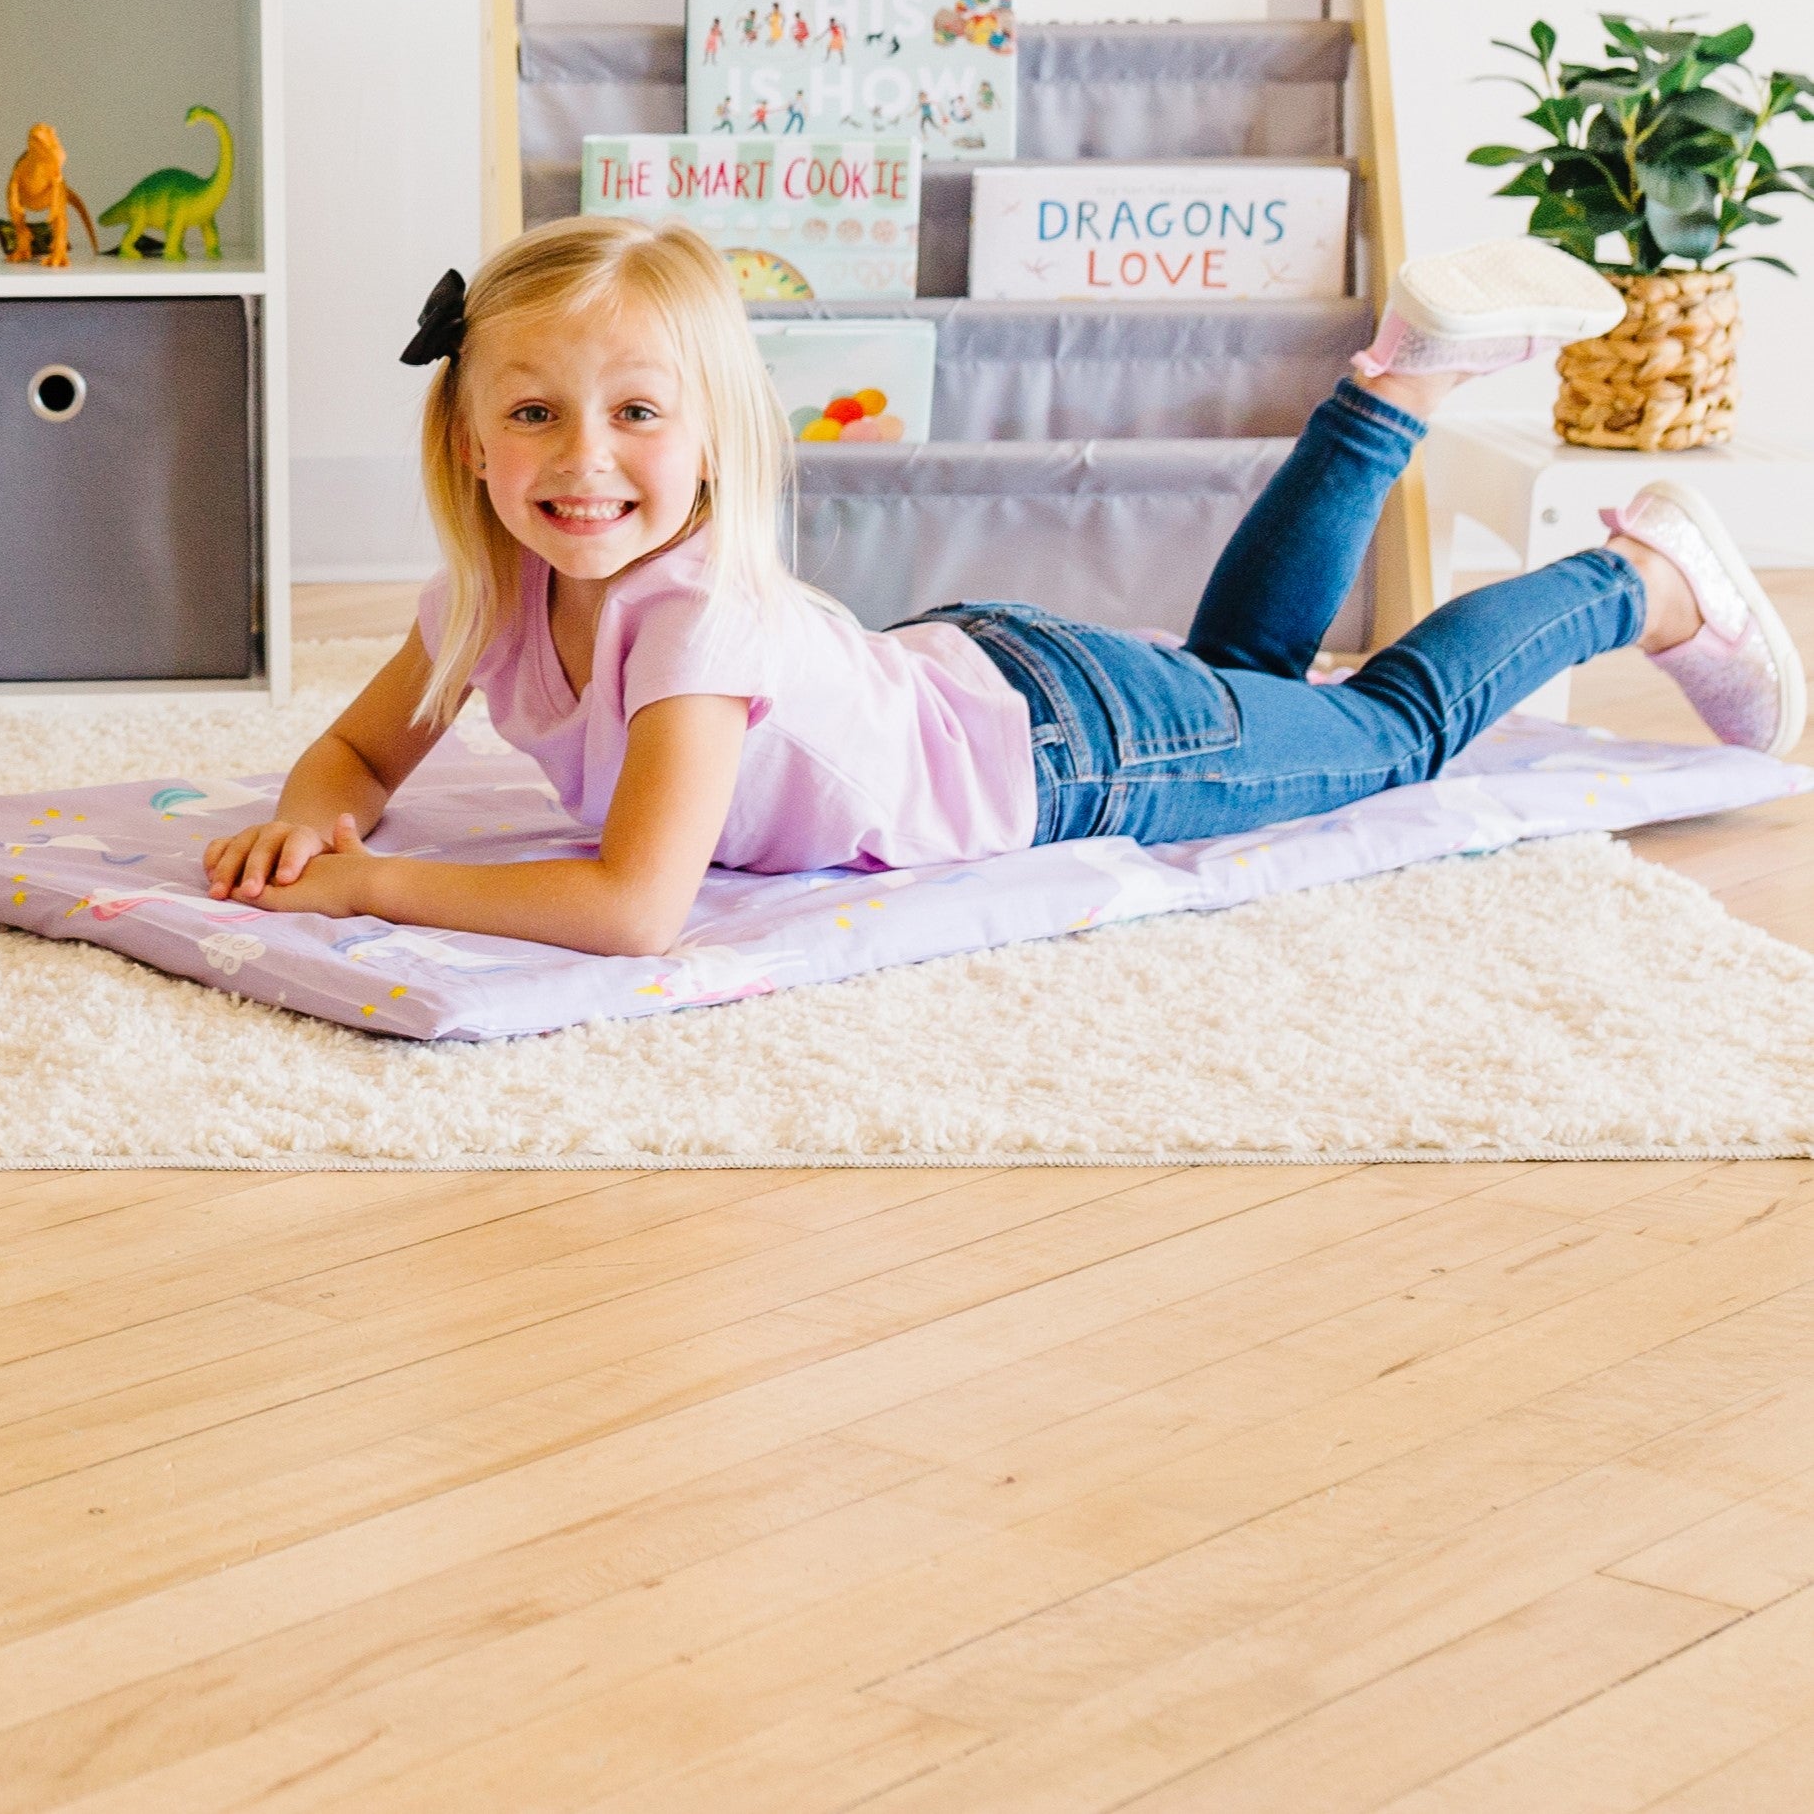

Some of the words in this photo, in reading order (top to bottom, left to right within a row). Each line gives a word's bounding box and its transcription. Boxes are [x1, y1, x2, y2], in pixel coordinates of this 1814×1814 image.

[727, 65, 786, 116] IS
[810, 65, 978, 118] HOW
[598, 157, 652, 201] THE
[666, 156, 772, 201] SMART
[783, 157, 907, 200] COOKIE
[1039, 200, 1287, 246] DRAGONS
[1088, 249, 1227, 289] LOVE
